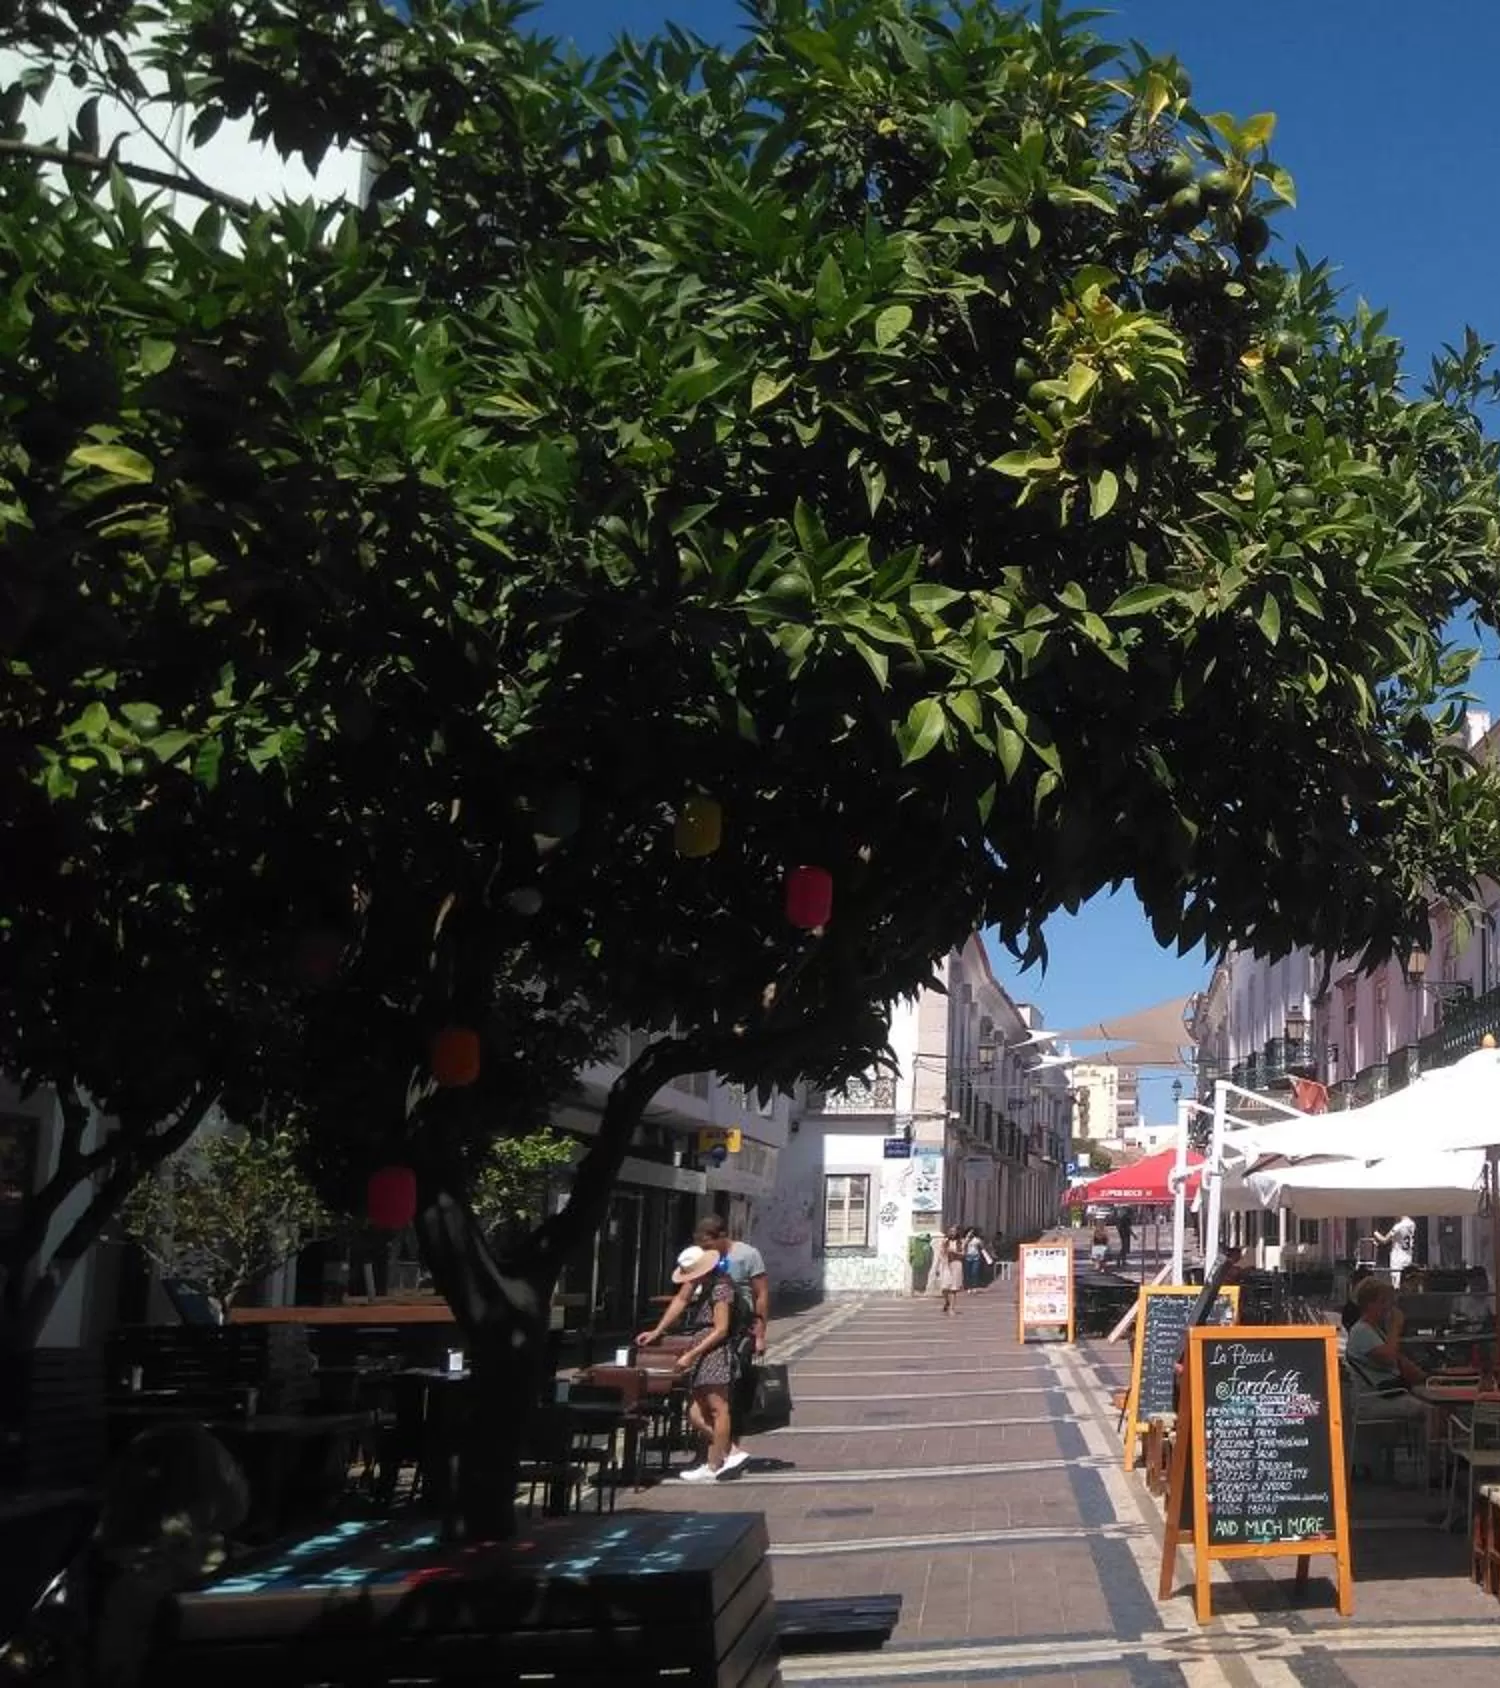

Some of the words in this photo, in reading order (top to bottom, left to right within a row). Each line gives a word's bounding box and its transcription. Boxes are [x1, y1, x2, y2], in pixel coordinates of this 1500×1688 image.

[1247, 1503, 1279, 1515] MENU
[1214, 1520, 1239, 1537] AND
[1244, 1519, 1283, 1536] MUCH
[1287, 1517, 1325, 1535] MORE
